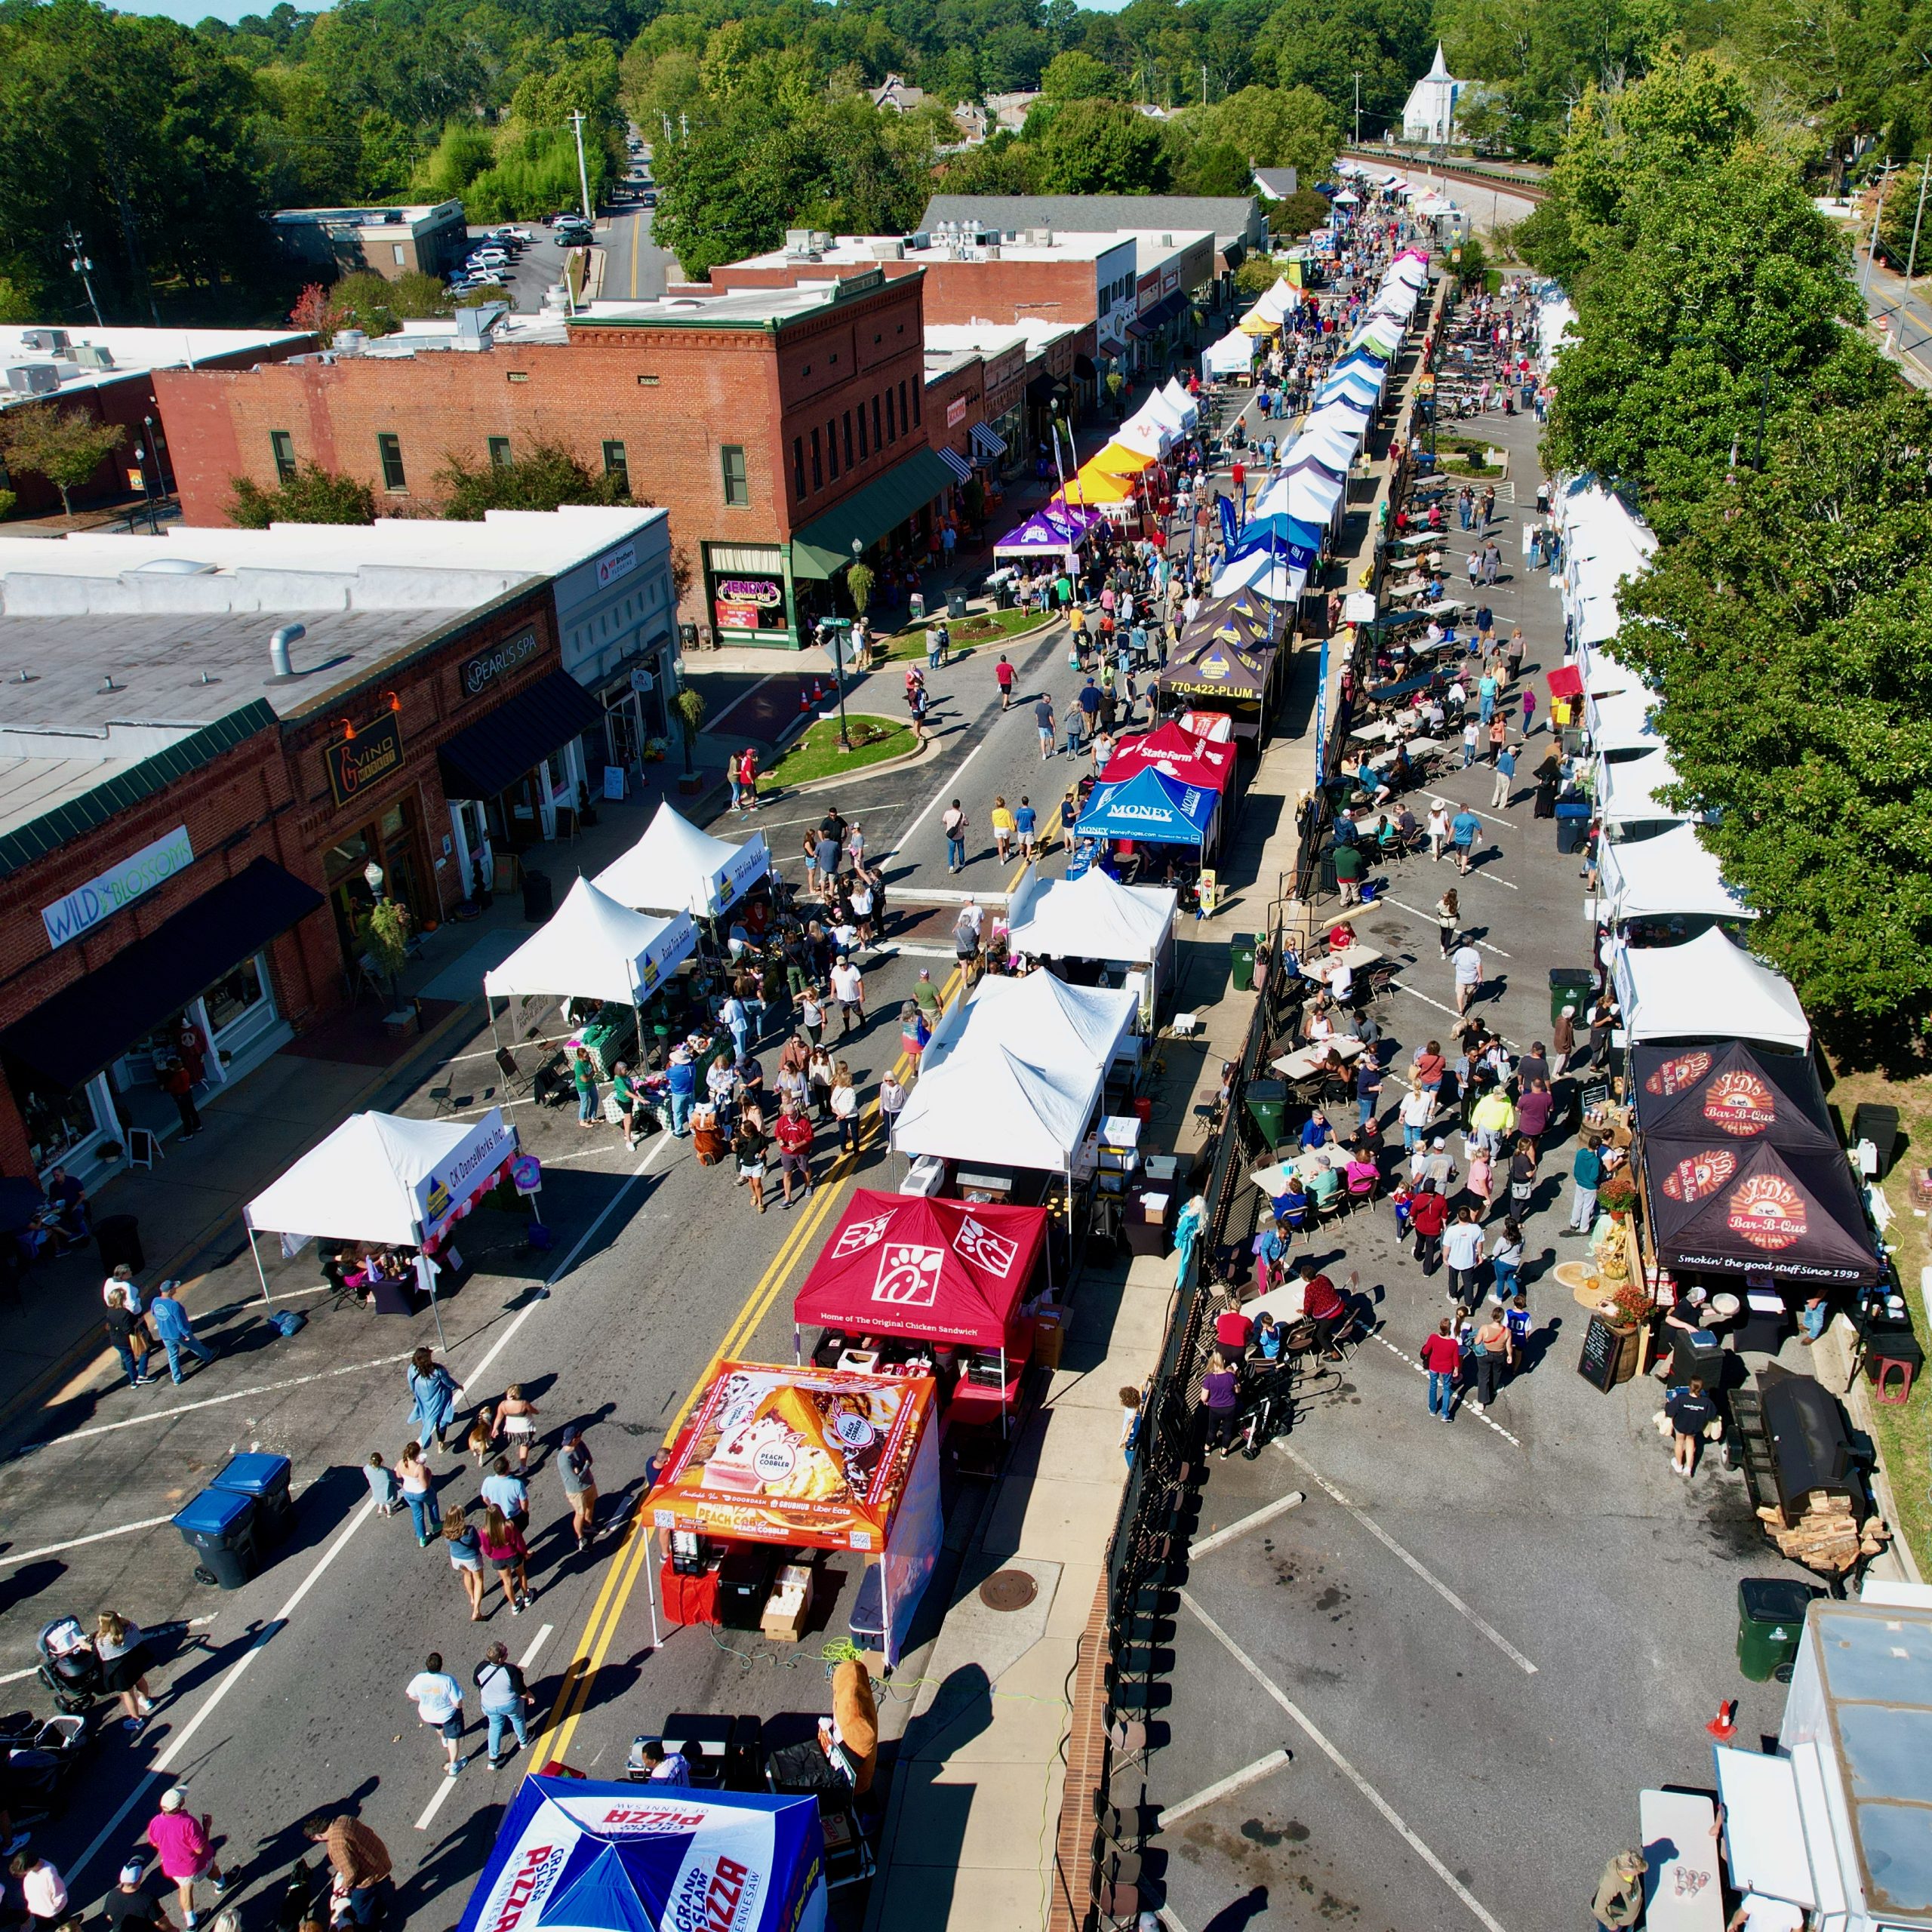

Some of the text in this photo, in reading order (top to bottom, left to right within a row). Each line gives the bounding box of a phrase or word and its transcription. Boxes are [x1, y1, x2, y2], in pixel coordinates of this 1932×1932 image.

[721, 580, 776, 597] HENRY'S
[475, 634, 537, 685] PEARL'S SPA
[1170, 681, 1253, 698] 770-422-PLUM
[1180, 786, 1198, 814] MONEY
[1111, 804, 1174, 819] MONEY
[1078, 826, 1109, 834] MONEY
[1109, 829, 1156, 838] MoneyPages.com
[45, 838, 190, 942] WILD BLOSSOMS
[1662, 1061, 1673, 1097] Bar-B-Que
[1705, 1106, 1775, 1122] Bar-B-Que
[449, 1128, 506, 1188] CK DanceWorks Inc.
[1680, 1161, 1694, 1203] Bar-B-Que
[1729, 1216, 1807, 1234] Bar-B-Que
[1678, 1254, 1860, 1279] Smokin' the good stuff Since 1999
[820, 1312, 978, 1337] Home of The Original Chicken Sandwich
[1510, 1319, 1524, 1331] 10
[844, 1421, 855, 1438] PEACH
[850, 1420, 863, 1441] COBBLER
[759, 1460, 790, 1468] COBBLER
[732, 1496, 767, 1506] DOORDASH
[779, 1500, 810, 1511] GRUBHUB
[813, 1505, 831, 1513] Uber
[832, 1506, 851, 1515] Eats
[698, 1508, 731, 1525] PEACH
[603, 1810, 706, 1826] PIZZA
[614, 1803, 688, 1813] KENNESAW
[531, 1863, 549, 1903] SLAM
[536, 1848, 565, 1901] GRAND
[493, 1844, 554, 1932] PIZZA
[675, 1867, 700, 1932] GRAND
[692, 1872, 708, 1927] SLAM
